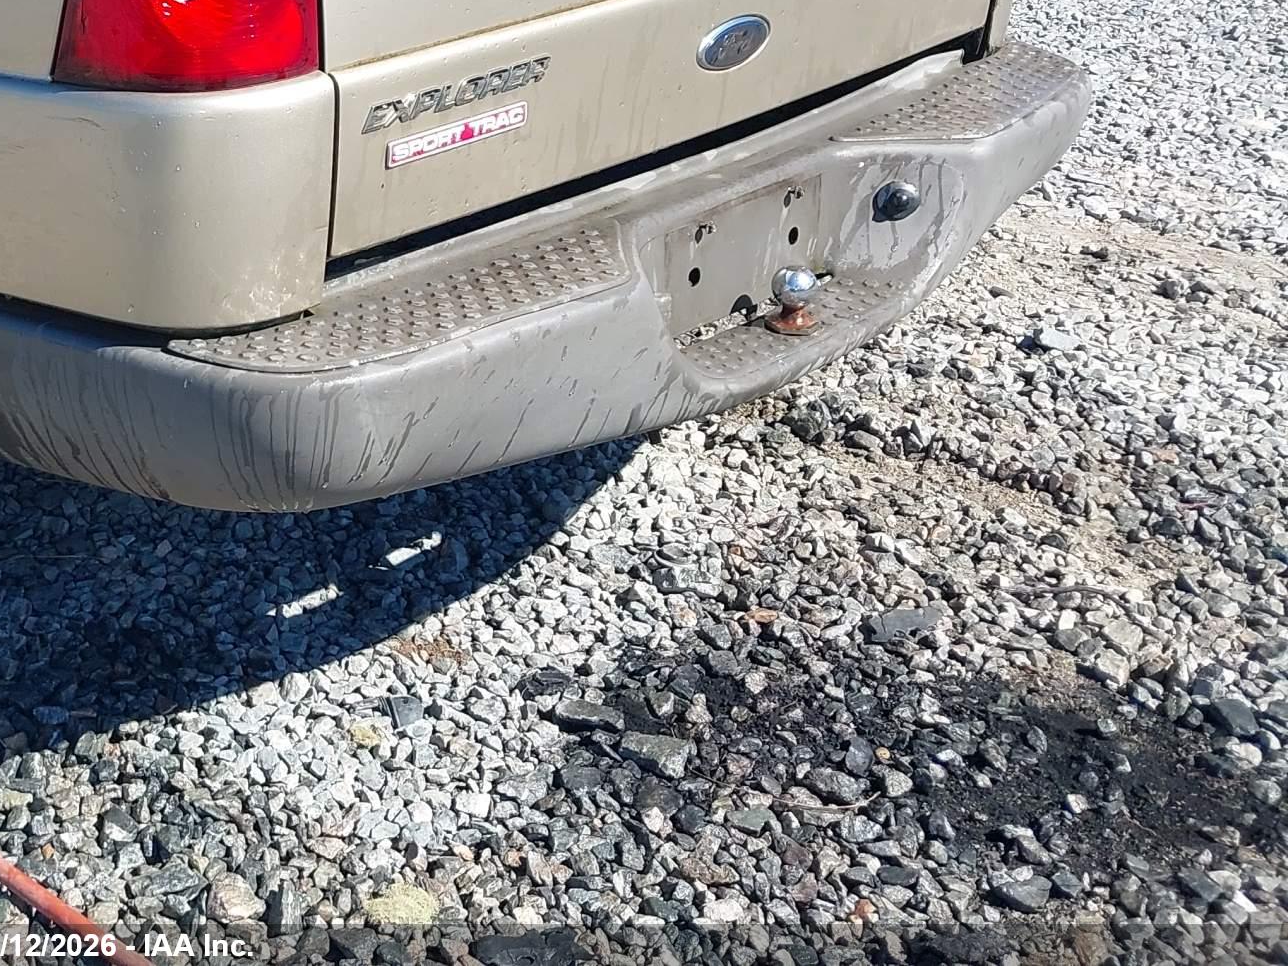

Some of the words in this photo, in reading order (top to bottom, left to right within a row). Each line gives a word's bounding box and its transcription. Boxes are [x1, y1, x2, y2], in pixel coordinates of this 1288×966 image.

[361, 55, 552, 134] EXPLORER
[391, 124, 465, 161] SPORT
[468, 105, 525, 139] TRAC
